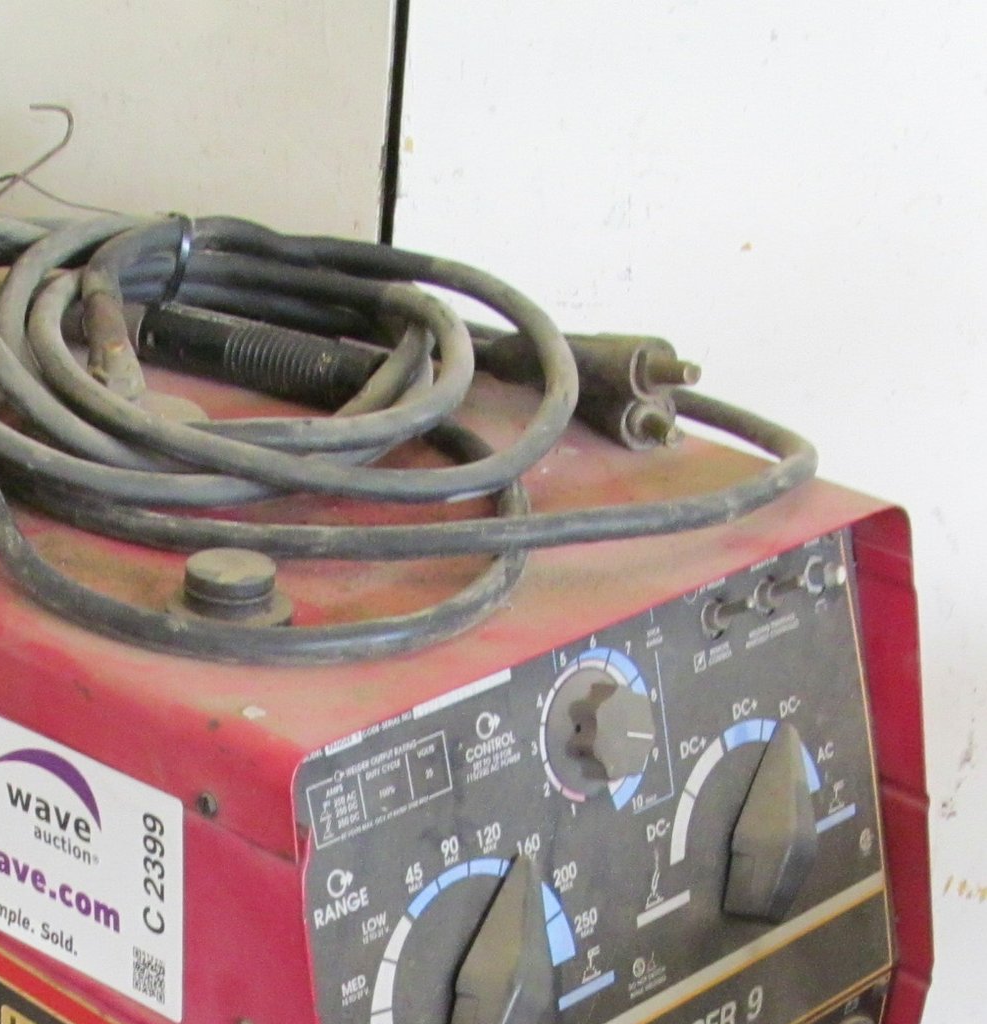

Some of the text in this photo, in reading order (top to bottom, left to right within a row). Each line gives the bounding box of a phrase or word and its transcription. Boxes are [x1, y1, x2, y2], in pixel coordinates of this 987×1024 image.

[589, 634, 597, 649] 6
[625, 639, 631, 656] 7
[536, 692, 544, 709] 4
[732, 697, 758, 721] DC+
[465, 731, 516, 763] CONTROL
[530, 740, 537, 756] 3
[679, 736, 707, 760] DC+
[817, 741, 835, 764] AC
[542, 781, 551, 798] 2
[6, 781, 92, 844] wave
[632, 795, 644, 811] 10
[440, 835, 459, 859] 90
[476, 821, 502, 849] 120
[516, 832, 541, 857] 160
[142, 812, 166, 936] C 2399
[405, 861, 424, 885] 45
[553, 861, 578, 888] 200
[313, 886, 370, 930] RANGE
[361, 910, 387, 935] LOW
[574, 907, 598, 934] 250
[41, 923, 78, 956] Sold.
[341, 974, 367, 998] MED
[746, 985, 764, 1022] 9
